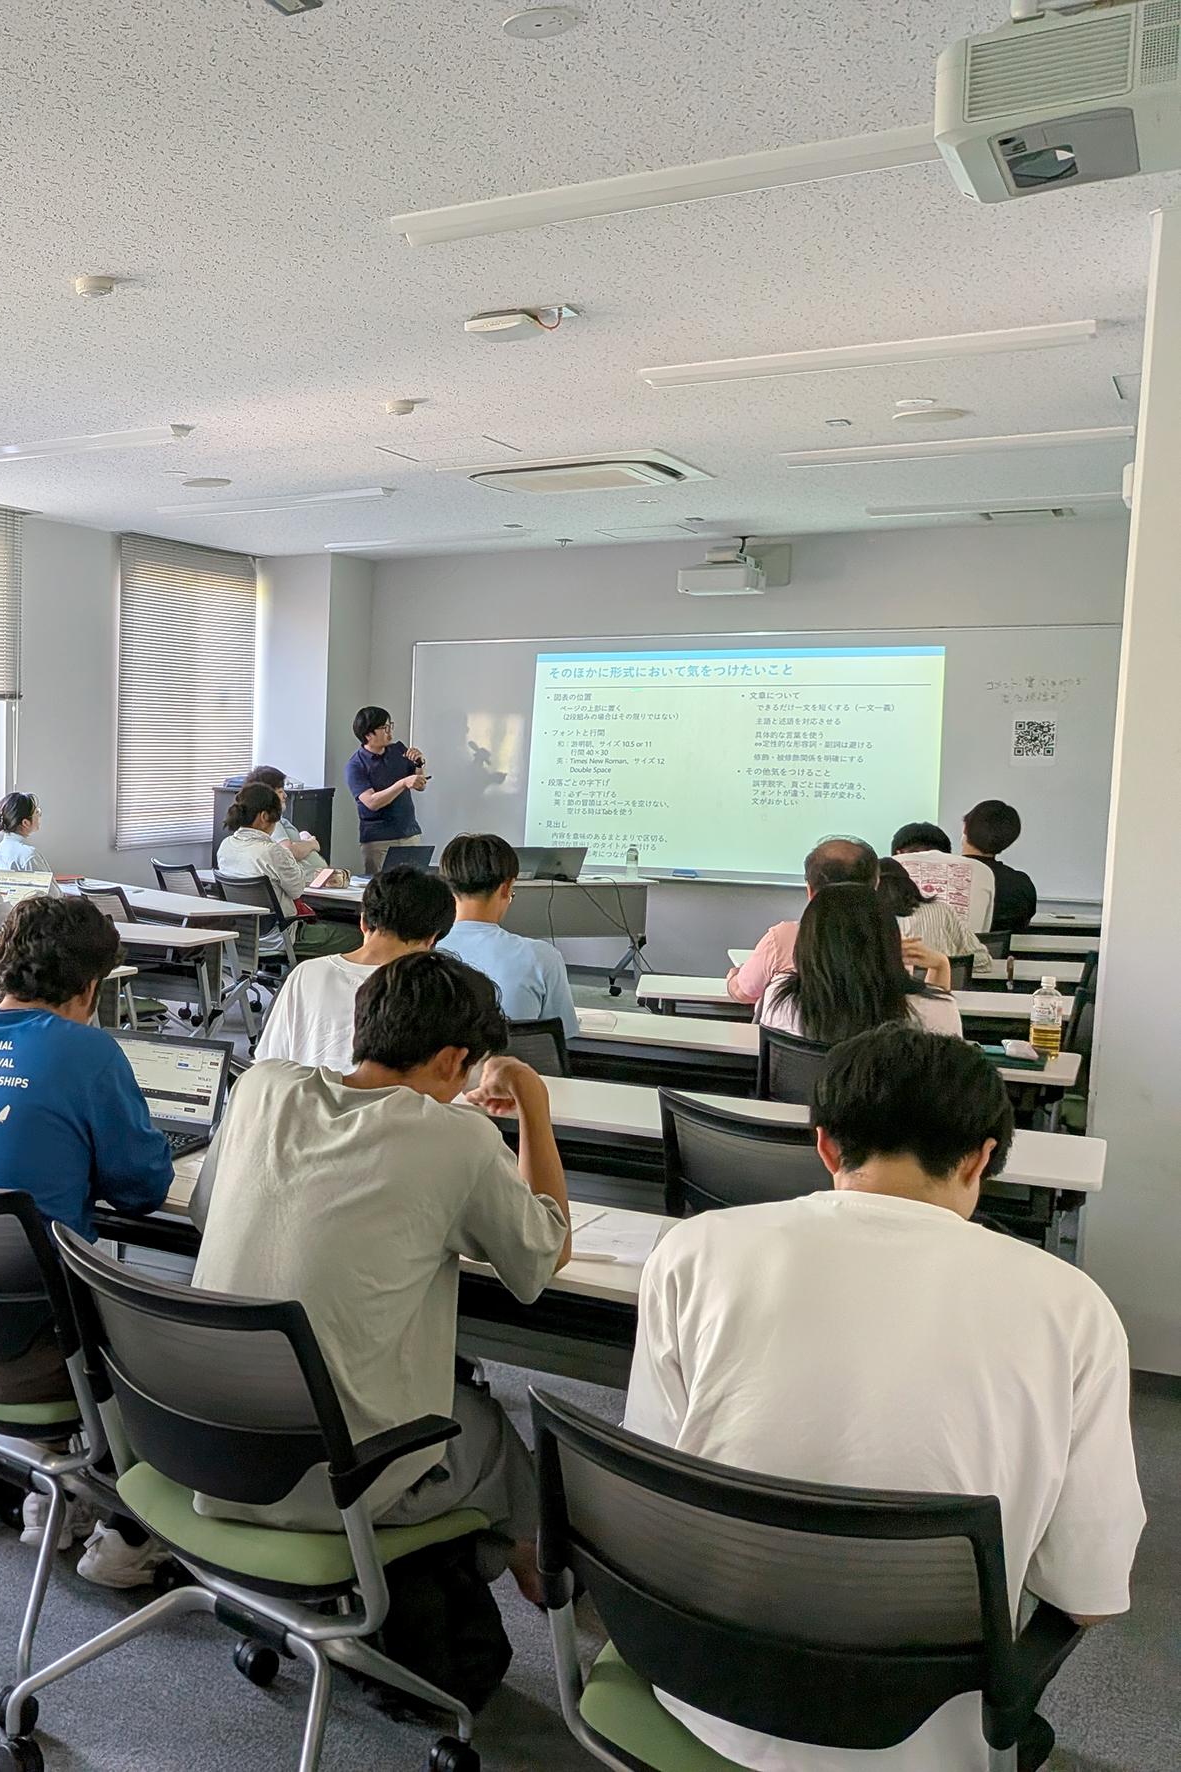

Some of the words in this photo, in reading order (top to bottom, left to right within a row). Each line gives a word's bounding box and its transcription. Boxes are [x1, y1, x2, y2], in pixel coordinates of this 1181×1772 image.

[549, 663, 793, 679] そのほかに形式において気をつけたいこと
[553, 693, 592, 701] 図表の位置
[749, 691, 800, 700] 文章について
[552, 728, 606, 737] フォントと行間
[593, 767, 612, 775] Space
[745, 768, 831, 777] その他気をつけること
[547, 778, 611, 787] 段落ごとの字下げ
[751, 798, 799, 806] 文がおかしい
[546, 820, 568, 828] 見出し
